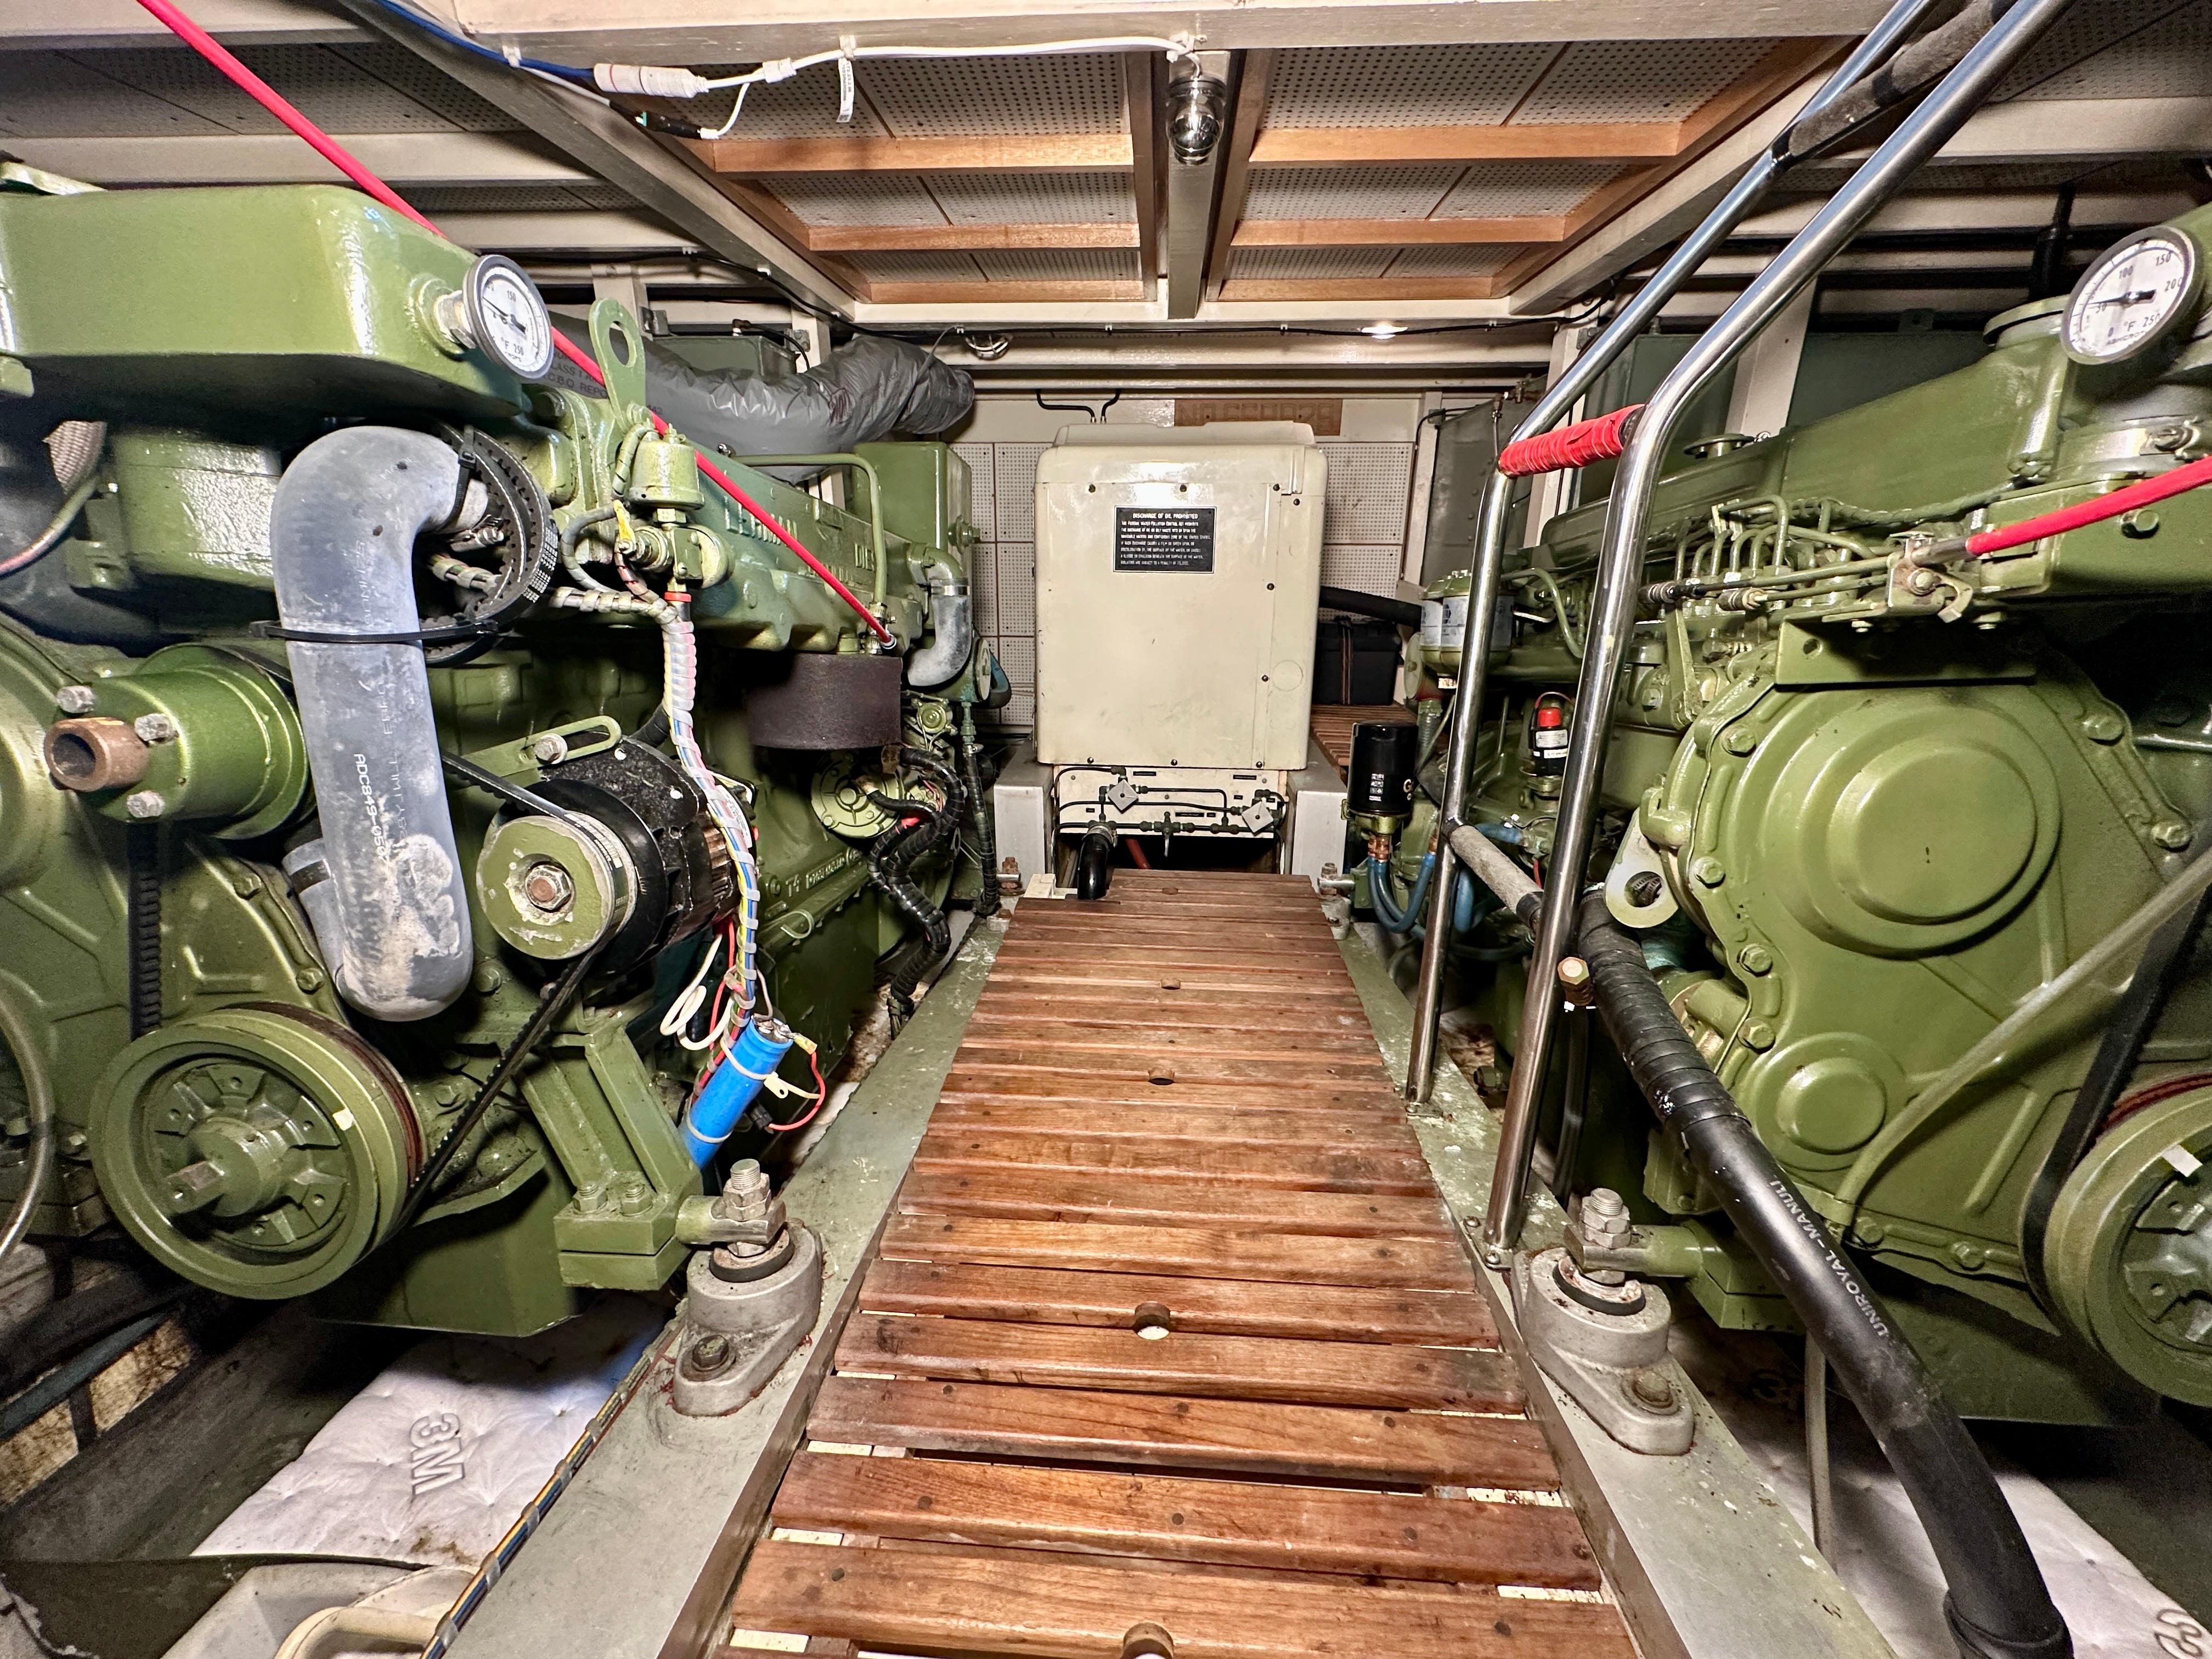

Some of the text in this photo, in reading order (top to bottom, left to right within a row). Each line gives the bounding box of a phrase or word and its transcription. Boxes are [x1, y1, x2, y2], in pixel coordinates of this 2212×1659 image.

[2155, 253, 2171, 267] 150
[2118, 265, 2134, 279] 100
[506, 290, 516, 303] 150
[2142, 313, 2160, 328] 250
[514, 344, 524, 356] 250
[1769, 1180, 1820, 1240] MANULI
[1825, 1249, 1889, 1338] UNIROYAL
[409, 1412, 466, 1497] 3M
